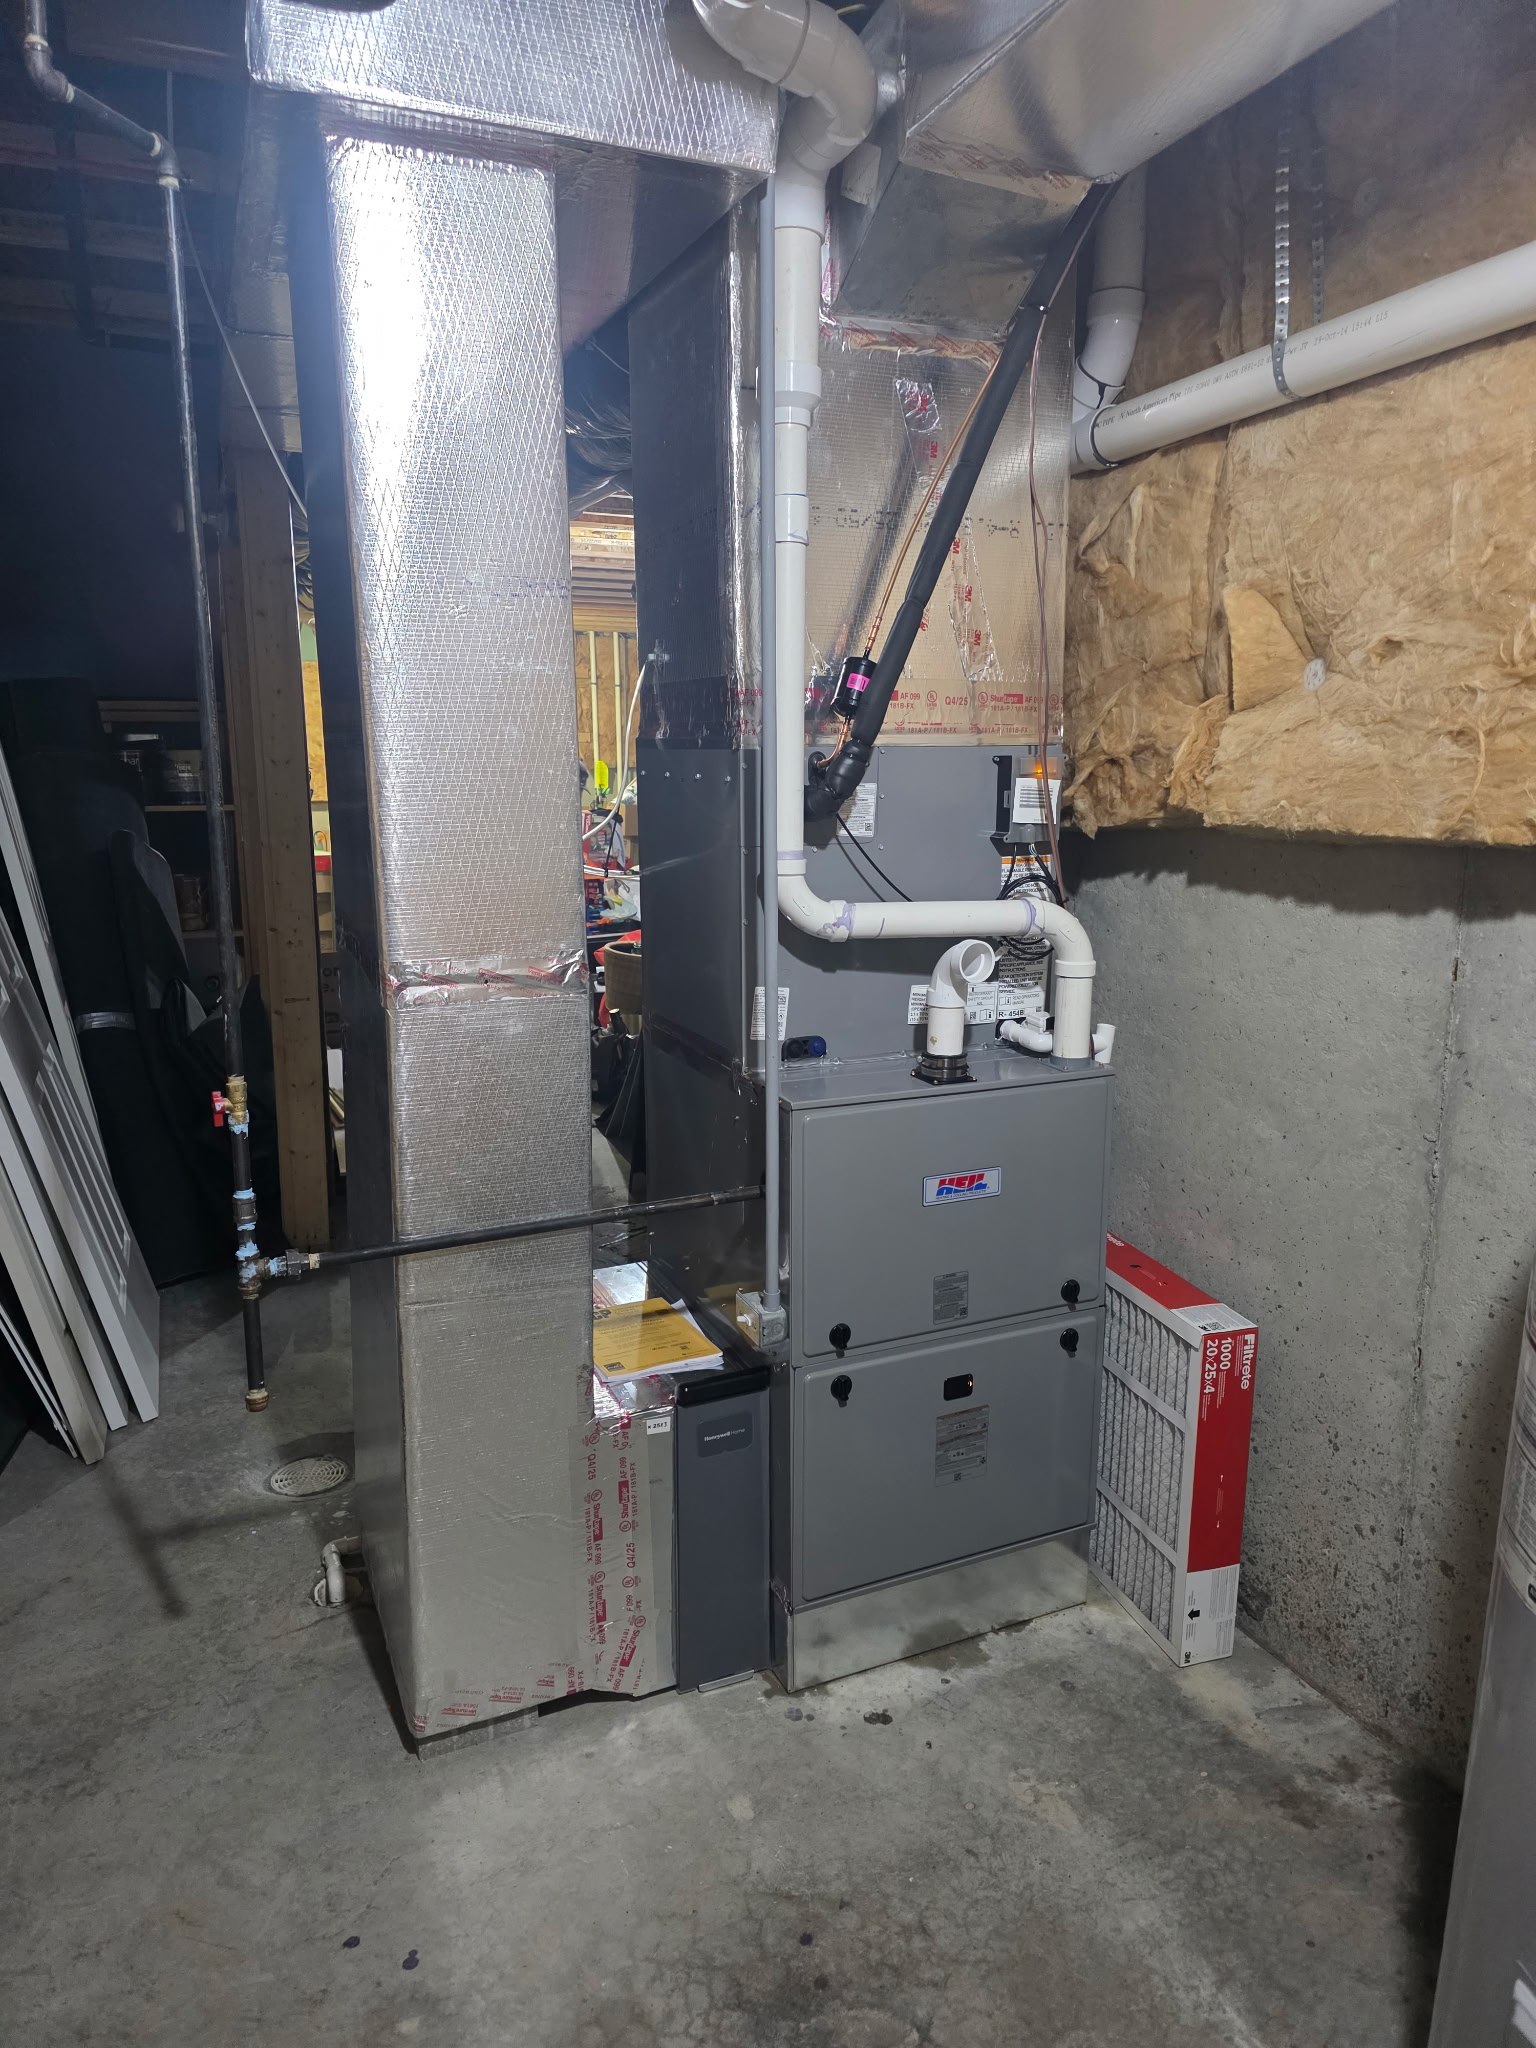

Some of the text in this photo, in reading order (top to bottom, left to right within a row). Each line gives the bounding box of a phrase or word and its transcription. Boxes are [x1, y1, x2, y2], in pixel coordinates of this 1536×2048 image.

[1126, 406, 1141, 418] North
[1141, 397, 1168, 412] American
[1168, 391, 1181, 402] Pipe
[930, 440, 938, 459] 3M
[964, 584, 973, 603] 3M
[973, 629, 982, 646] 3M
[909, 692, 921, 700] 099
[945, 696, 968, 706] Q4/25
[936, 1173, 988, 1196] HEIL
[1219, 1337, 1233, 1370] 1000
[1241, 1333, 1256, 1390] Filtrete
[704, 1431, 730, 1442] Honeywell
[587, 1453, 596, 1481] Q4/25
[618, 1456, 630, 1518] Shurtape AF 099
[593, 1502, 603, 1542] Shurtape
[626, 1542, 635, 1568] Q4/25
[595, 1584, 606, 1624] Shurtape
[619, 1628, 630, 1650] 181A-P
[607, 1656, 619, 1683] 181B-FX
[612, 1629, 640, 1691] Shurtape AF 099
[1184, 1651, 1192, 1664] 3M
[567, 1666, 575, 1679] 099
